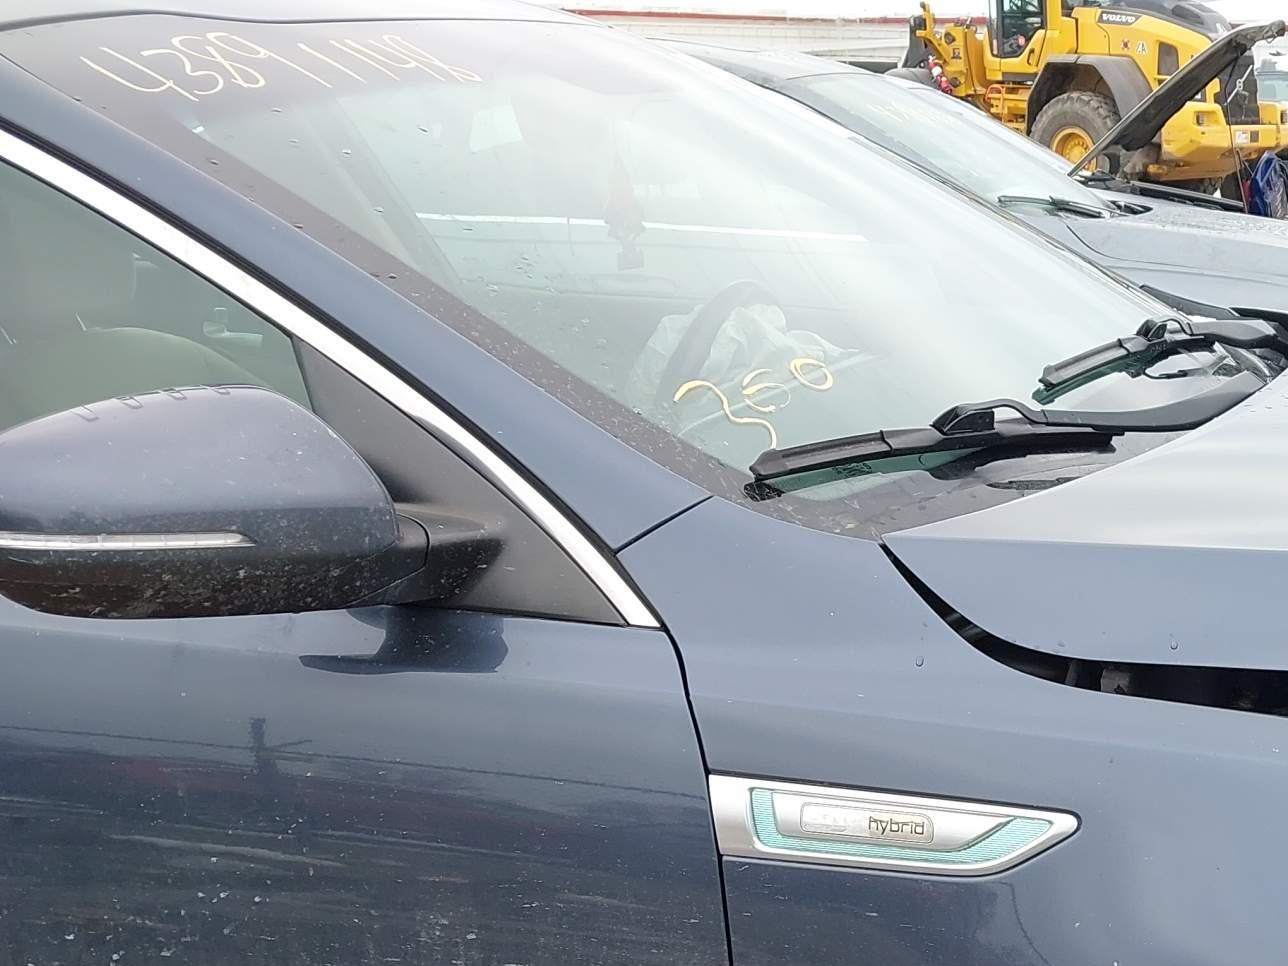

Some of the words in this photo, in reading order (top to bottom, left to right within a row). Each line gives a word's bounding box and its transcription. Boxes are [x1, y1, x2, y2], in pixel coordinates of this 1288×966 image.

[1102, 13, 1136, 23] VOLVO
[80, 32, 482, 102] 43891148
[868, 815, 926, 836] hybrid
